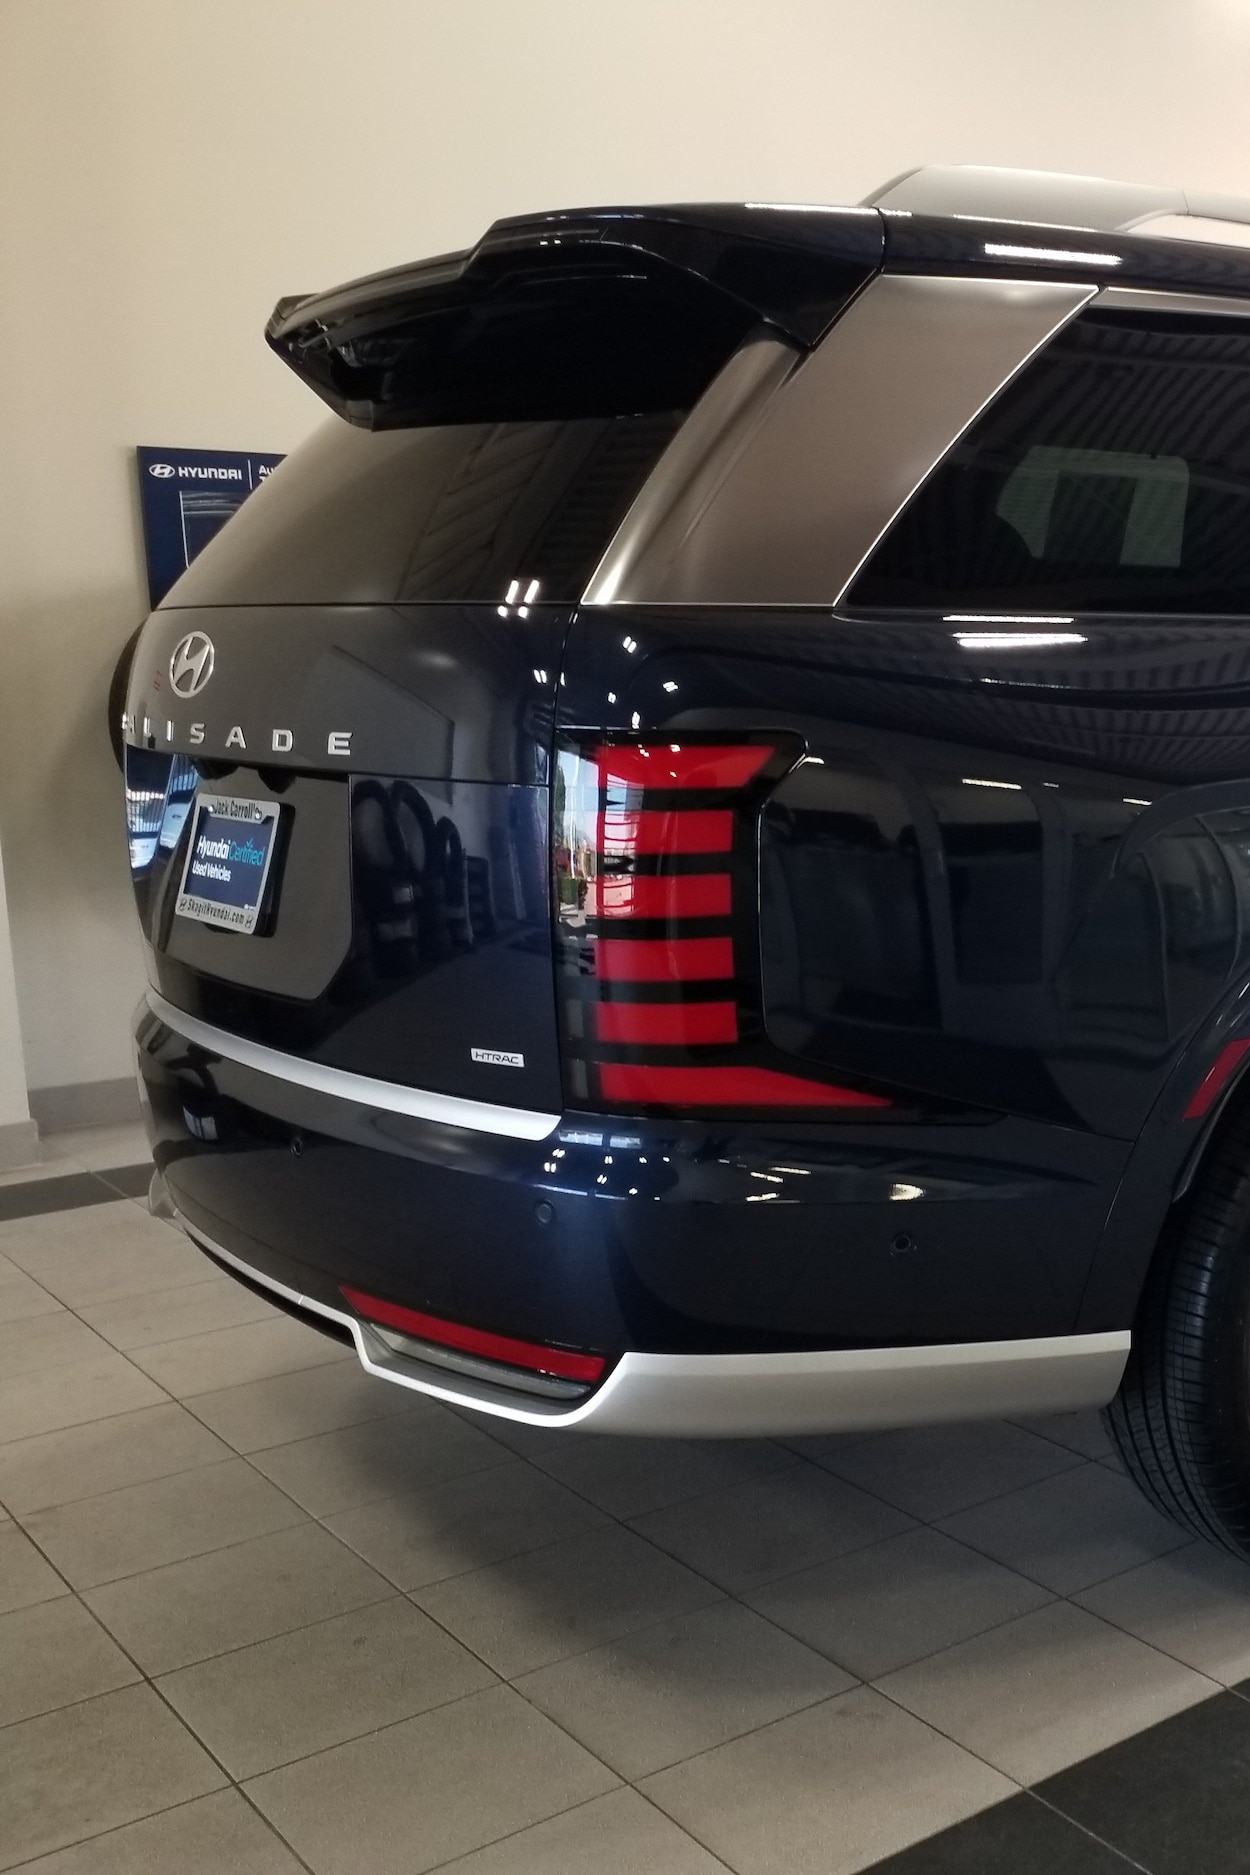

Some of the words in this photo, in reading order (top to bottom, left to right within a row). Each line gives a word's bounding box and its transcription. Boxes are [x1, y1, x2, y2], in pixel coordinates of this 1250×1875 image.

[178, 466, 243, 480] HYUNDAI
[196, 835, 231, 860] Hyundai
[228, 839, 266, 867] Certified
[191, 860, 208, 878] Used
[207, 862, 232, 882] Vehicles
[474, 1051, 520, 1065] HTRAC
